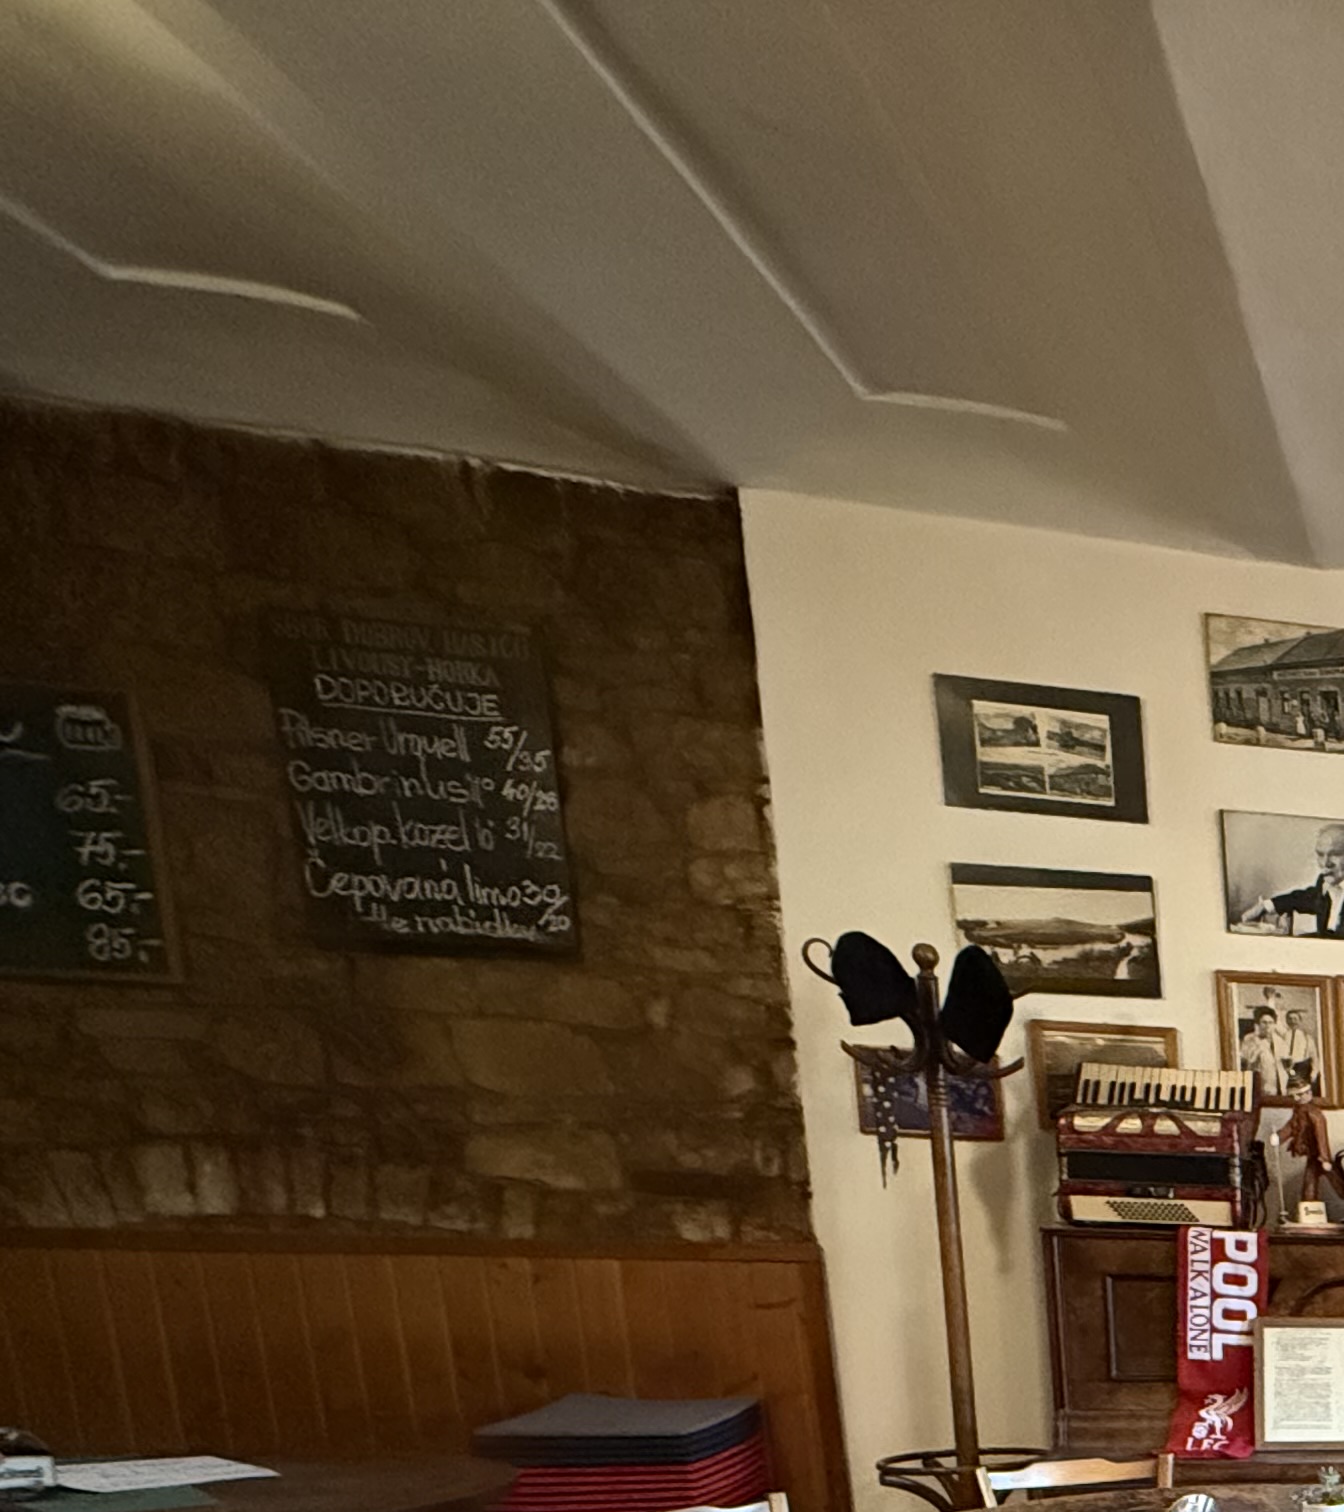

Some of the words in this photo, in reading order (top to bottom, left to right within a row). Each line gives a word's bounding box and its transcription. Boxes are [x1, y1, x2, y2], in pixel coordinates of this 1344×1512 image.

[314, 672, 501, 717] DOPORUČUJE
[279, 707, 377, 752] Pilsner
[304, 849, 464, 912] Čepovaná
[463, 863, 519, 906] limo
[1188, 1228, 1209, 1283] WALK
[1188, 1287, 1209, 1354] ALONE
[1212, 1230, 1258, 1361] POOL
